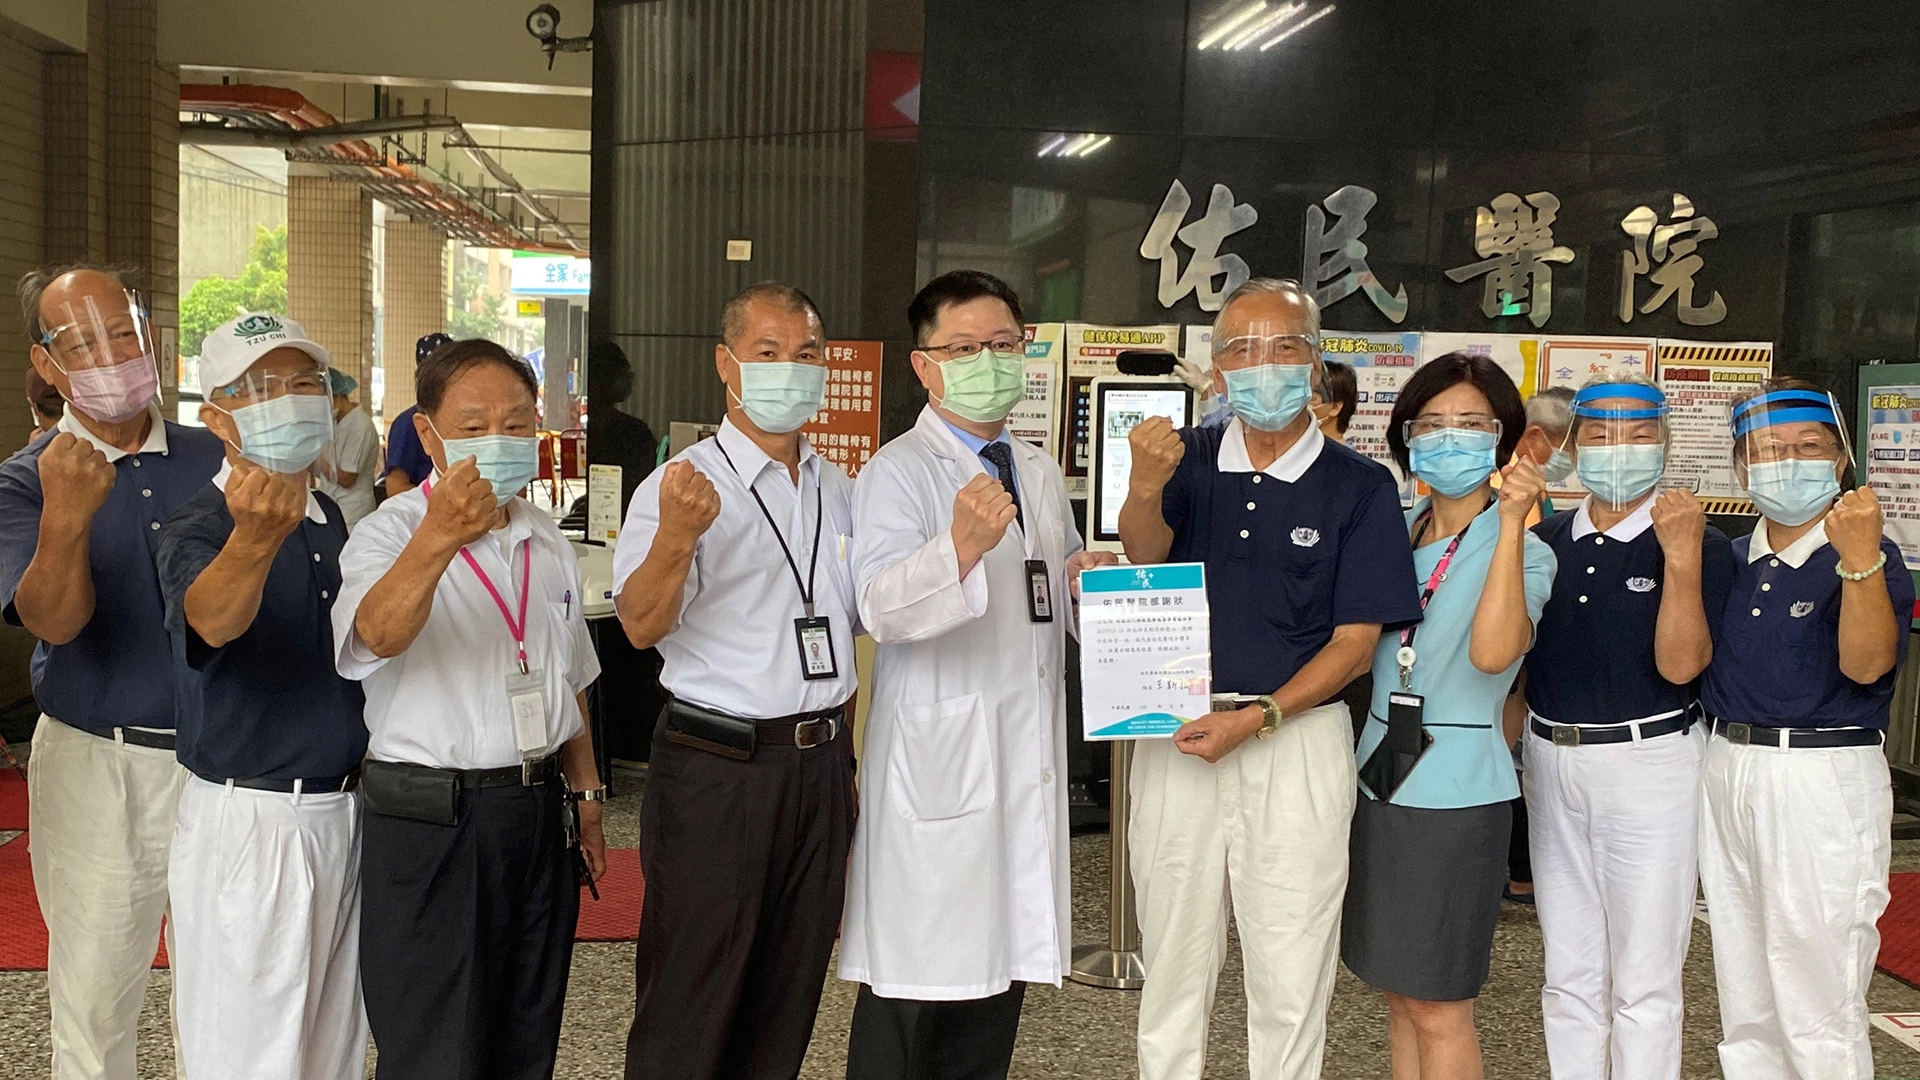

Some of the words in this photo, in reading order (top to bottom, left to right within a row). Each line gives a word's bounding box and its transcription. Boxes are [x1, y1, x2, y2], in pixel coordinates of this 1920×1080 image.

[1140, 179, 1727, 327] 佑民醫院
[545, 263, 568, 282] 全家
[246, 335, 267, 346] TZU
[1083, 330, 1165, 344] 健保快易通APP
[1556, 367, 1574, 379] 全
[1102, 596, 1184, 606] 佑民醫院感謝狀
